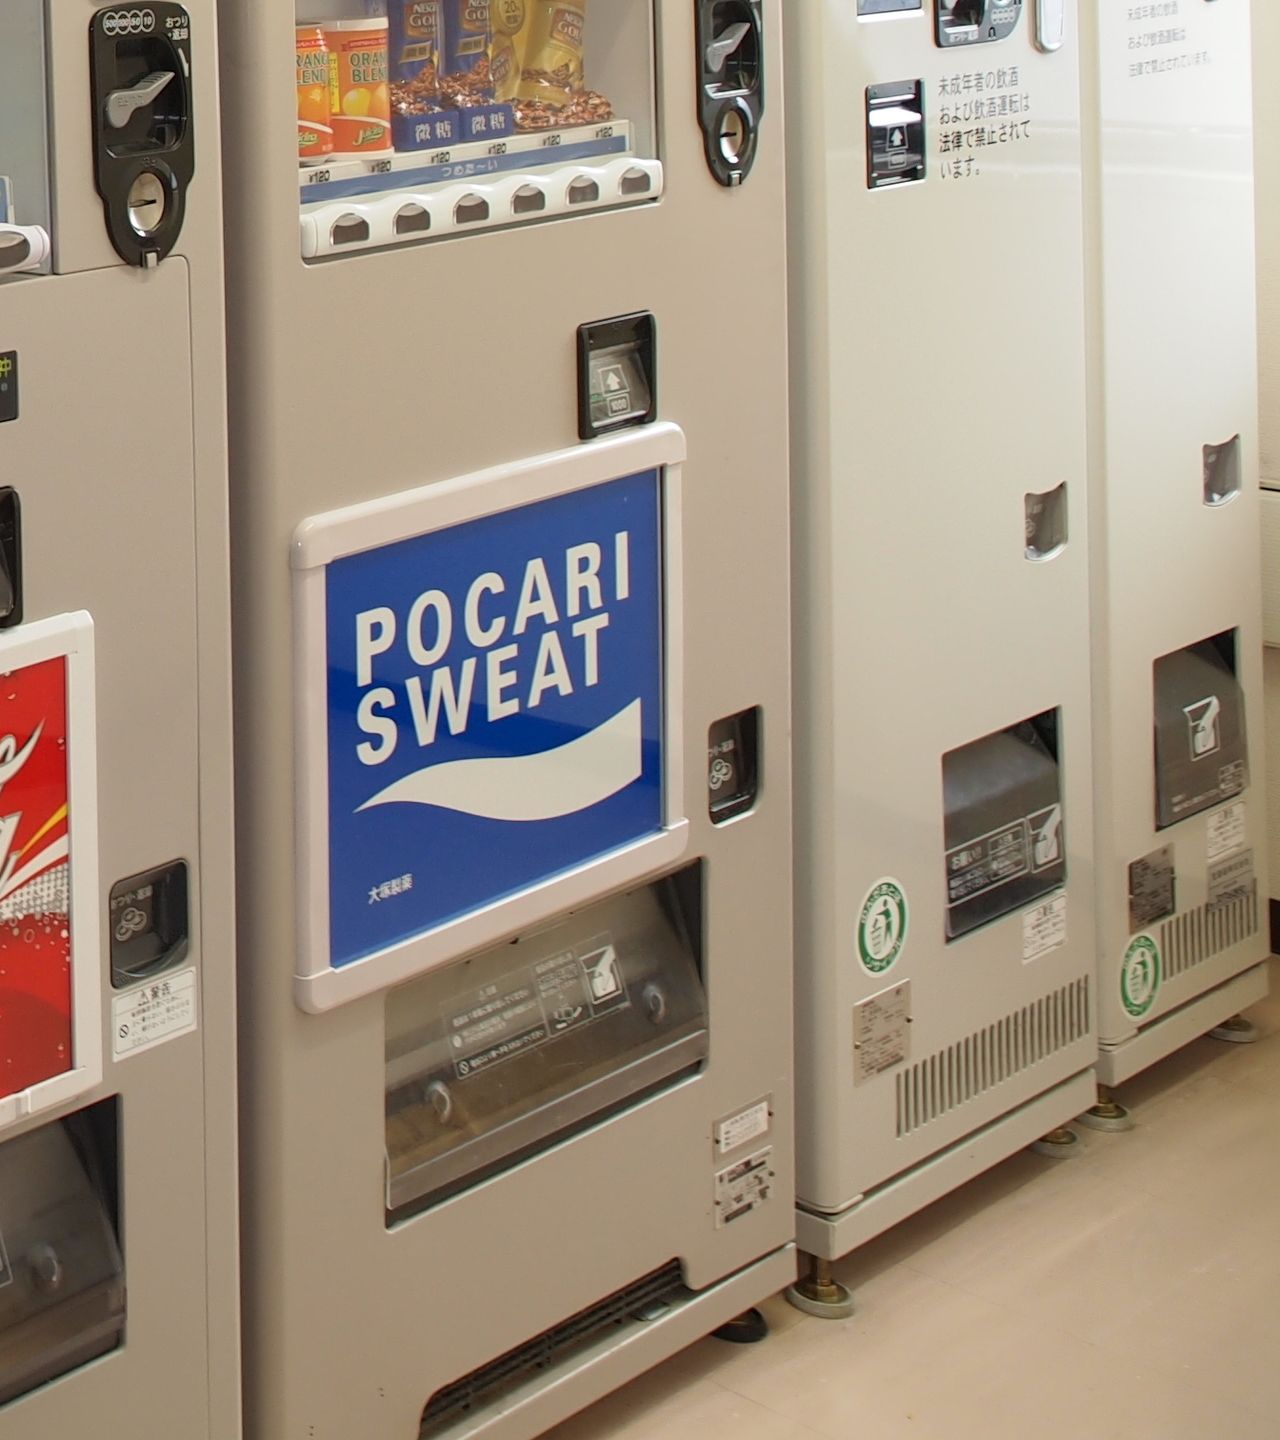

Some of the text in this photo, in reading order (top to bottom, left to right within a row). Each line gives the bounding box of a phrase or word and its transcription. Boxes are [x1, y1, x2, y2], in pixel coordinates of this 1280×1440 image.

[166, 16, 188, 27] おつり
[939, 66, 1019, 96] 未成年者の飲酒
[939, 94, 1030, 125] および飲酒運転は
[939, 120, 1031, 153] 法律で禁止されて
[355, 530, 630, 688] POCARI
[355, 612, 610, 768] SWEAT
[367, 873, 414, 905] 大塚製薬
